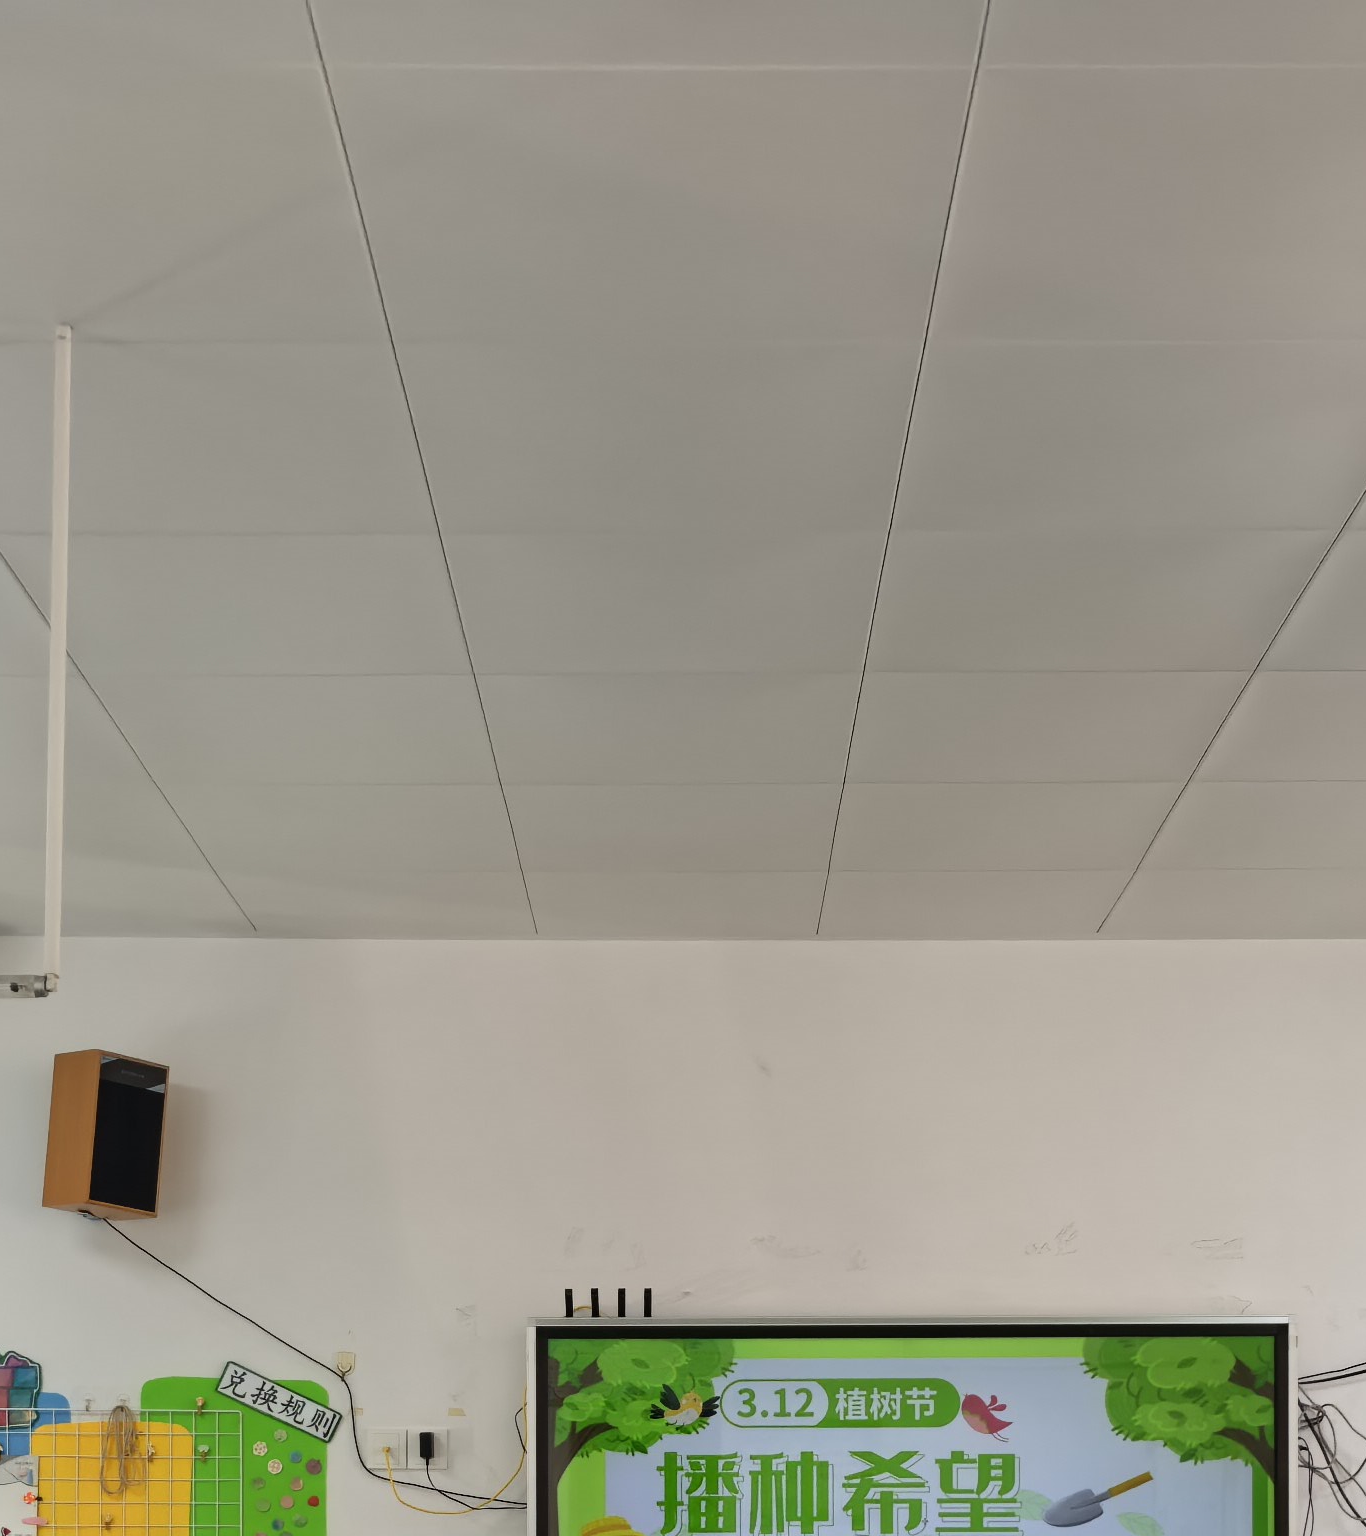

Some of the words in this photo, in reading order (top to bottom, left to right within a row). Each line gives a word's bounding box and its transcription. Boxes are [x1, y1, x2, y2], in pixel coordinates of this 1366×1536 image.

[220, 1369, 336, 1438] 兑换规则
[737, 1388, 815, 1418] 3.12
[834, 1387, 937, 1422] 植树节
[655, 1451, 1024, 1536] 播种希望
